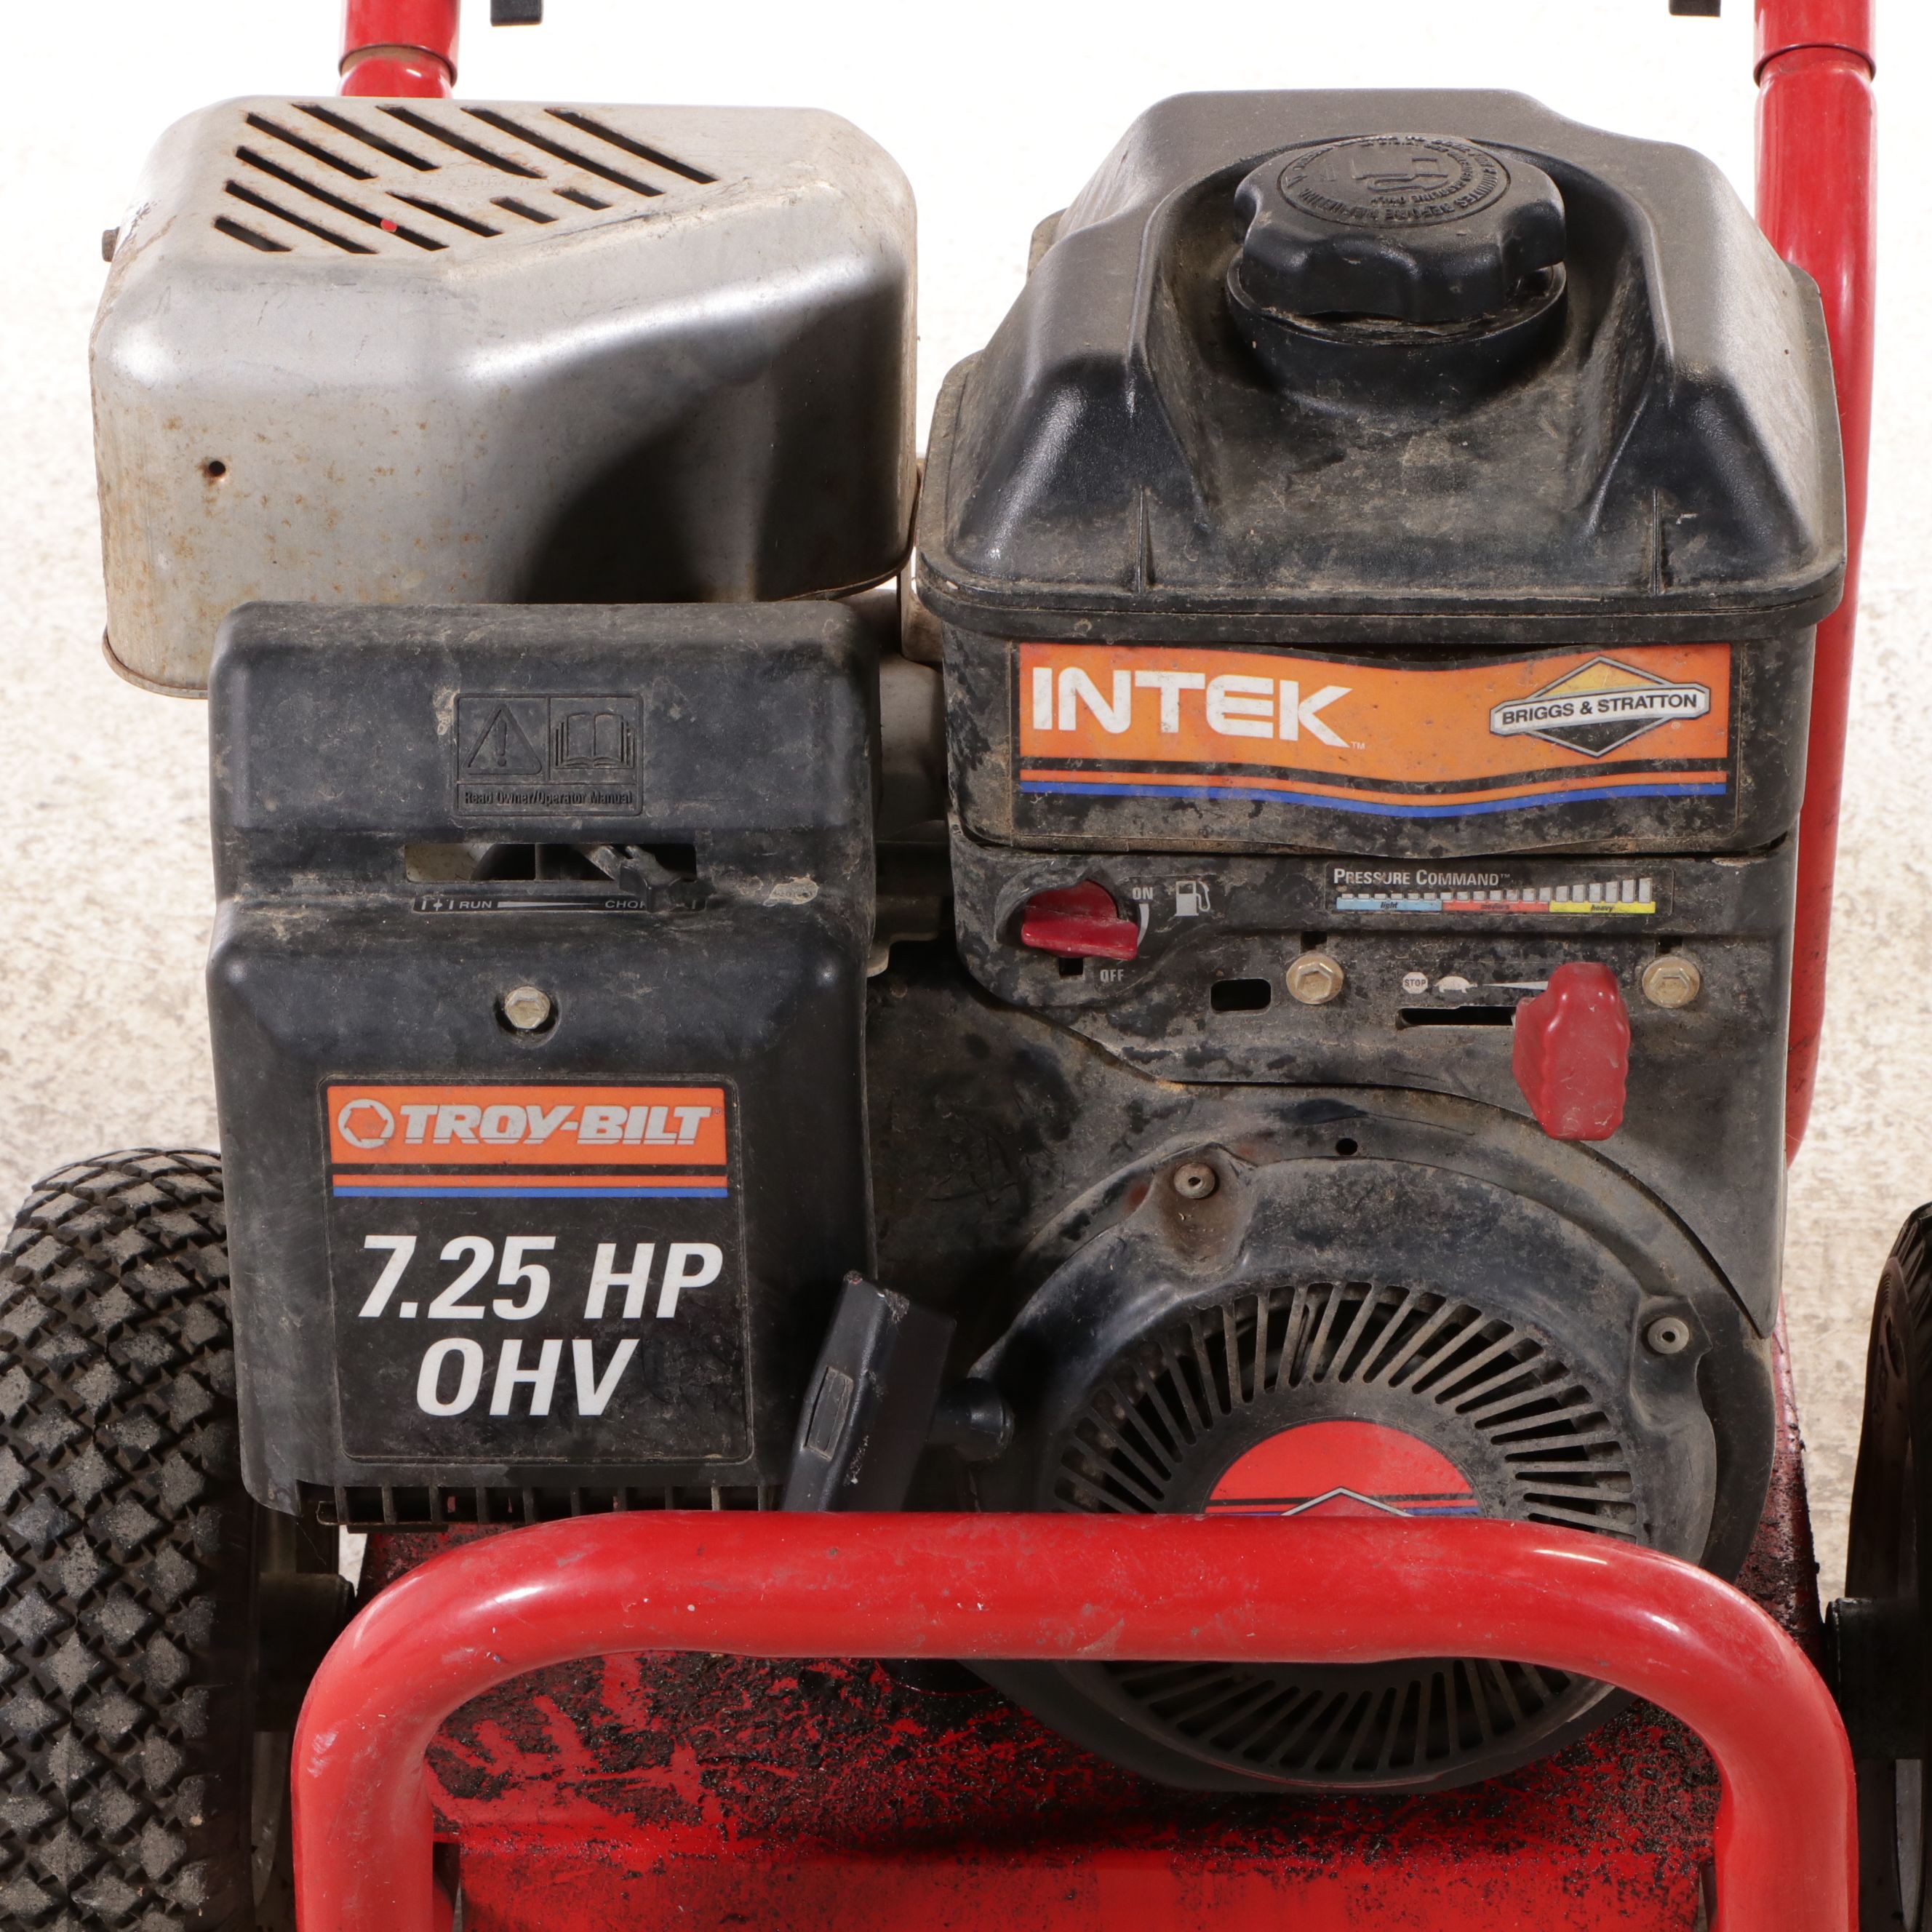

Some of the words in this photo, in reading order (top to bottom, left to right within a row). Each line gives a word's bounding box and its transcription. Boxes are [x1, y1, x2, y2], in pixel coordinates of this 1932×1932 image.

[1455, 174, 1498, 209] MINUTES
[1033, 667, 1352, 748] INTEK
[1502, 703, 1574, 725] BRIGGS
[1580, 700, 1592, 715] &
[1597, 694, 1697, 713] STRATTON
[465, 791, 493, 805] Read
[497, 791, 586, 807] Owner/Operator
[591, 791, 632, 805] Manual
[459, 901, 492, 909] RUN
[1132, 887, 1154, 900] ON
[1380, 901, 1398, 909] light
[1100, 969, 1124, 982] OFF
[1404, 978, 1426, 987] STOP
[399, 1104, 712, 1146] TROY-BILT
[358, 1235, 556, 1321] 7.25
[583, 1242, 723, 1319] HP
[416, 1338, 639, 1416] OHV
